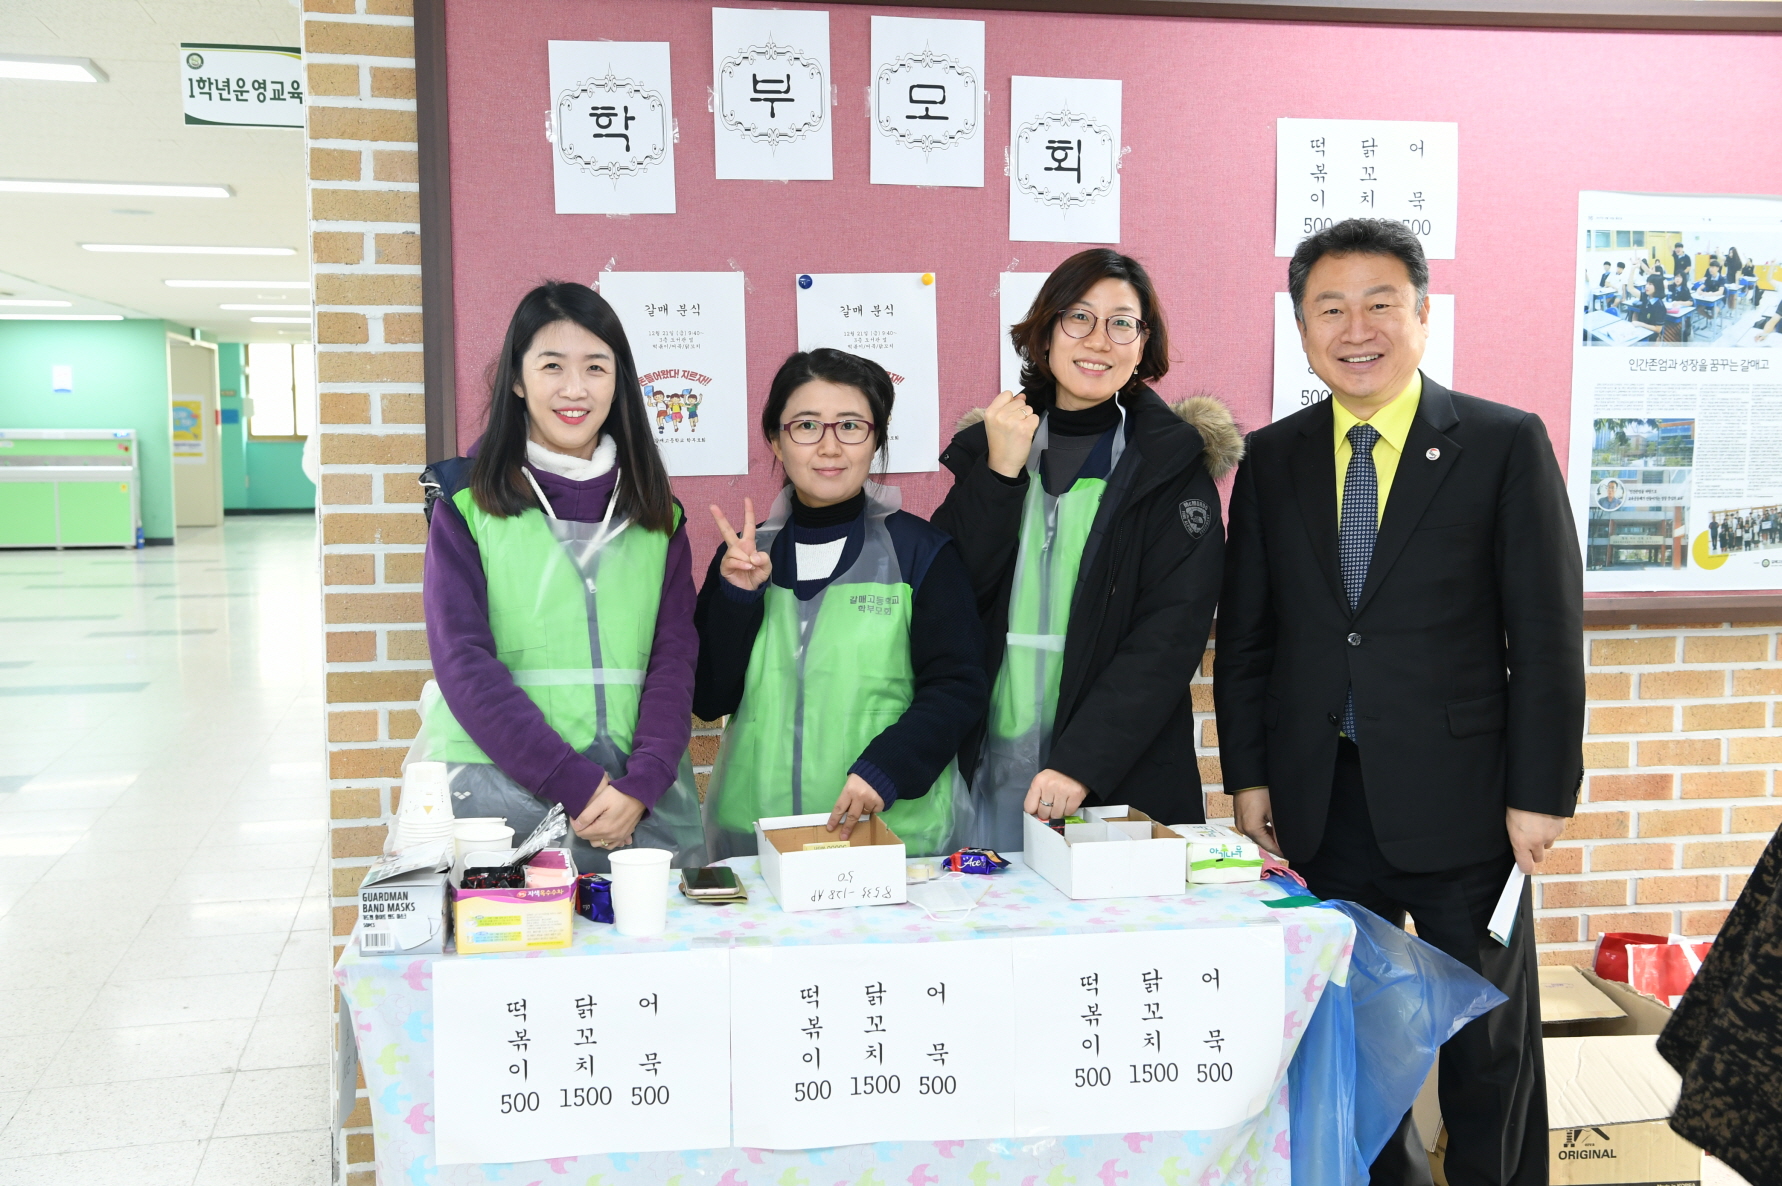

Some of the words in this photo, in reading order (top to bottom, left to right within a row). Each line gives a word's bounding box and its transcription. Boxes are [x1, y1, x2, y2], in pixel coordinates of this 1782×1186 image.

[589, 105, 636, 153] 학
[749, 73, 795, 119] 부
[905, 83, 949, 121] 모
[1043, 139, 1082, 184] 회
[644, 302, 669, 318] 갈매
[676, 302, 701, 318] 분식
[840, 303, 863, 319] 갈매
[871, 303, 894, 318] 분식
[1628, 358, 1678, 372] 인간존엄과
[1679, 358, 1708, 373] 성장을
[1709, 358, 1739, 373] 꿈꾸는
[1740, 359, 1770, 373] 갈매고
[362, 891, 409, 902] GUARDMAN
[363, 903, 385, 913] BAND
[387, 902, 416, 913] MASKS
[1074, 1066, 1112, 1088] 500
[1129, 1062, 1179, 1084] 1500
[1196, 1062, 1233, 1083] 500
[794, 1079, 832, 1102] 500
[850, 1074, 901, 1096] 1500
[918, 1075, 957, 1095] 500
[500, 1091, 540, 1114] 500
[559, 1085, 613, 1108] 1500
[631, 1085, 670, 1106] 500
[1558, 1149, 1617, 1160] ORIGINAL
